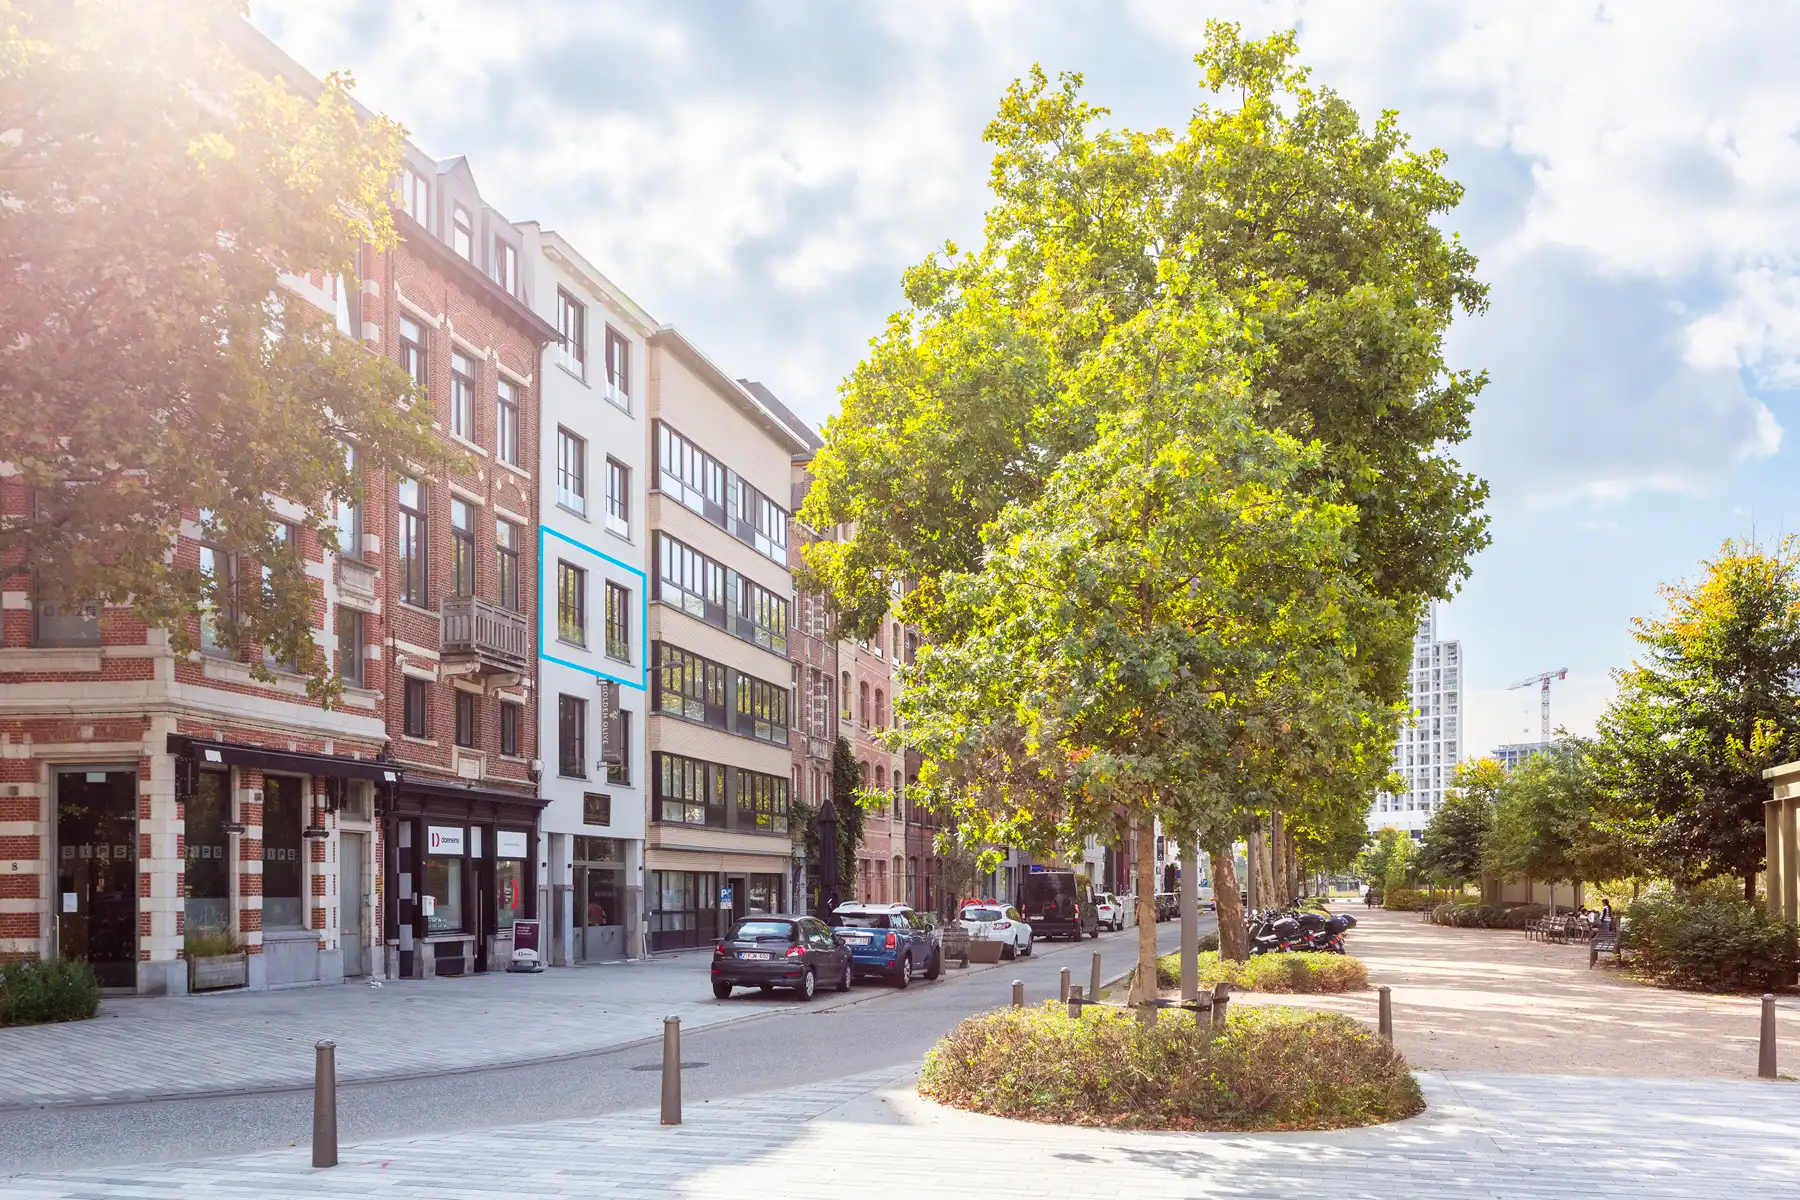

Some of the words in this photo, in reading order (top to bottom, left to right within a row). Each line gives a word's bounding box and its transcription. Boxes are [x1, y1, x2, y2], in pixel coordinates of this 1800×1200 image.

[64, 847, 125, 857] SIPS
[11, 862, 18, 871] 8
[721, 889, 727, 898] P
